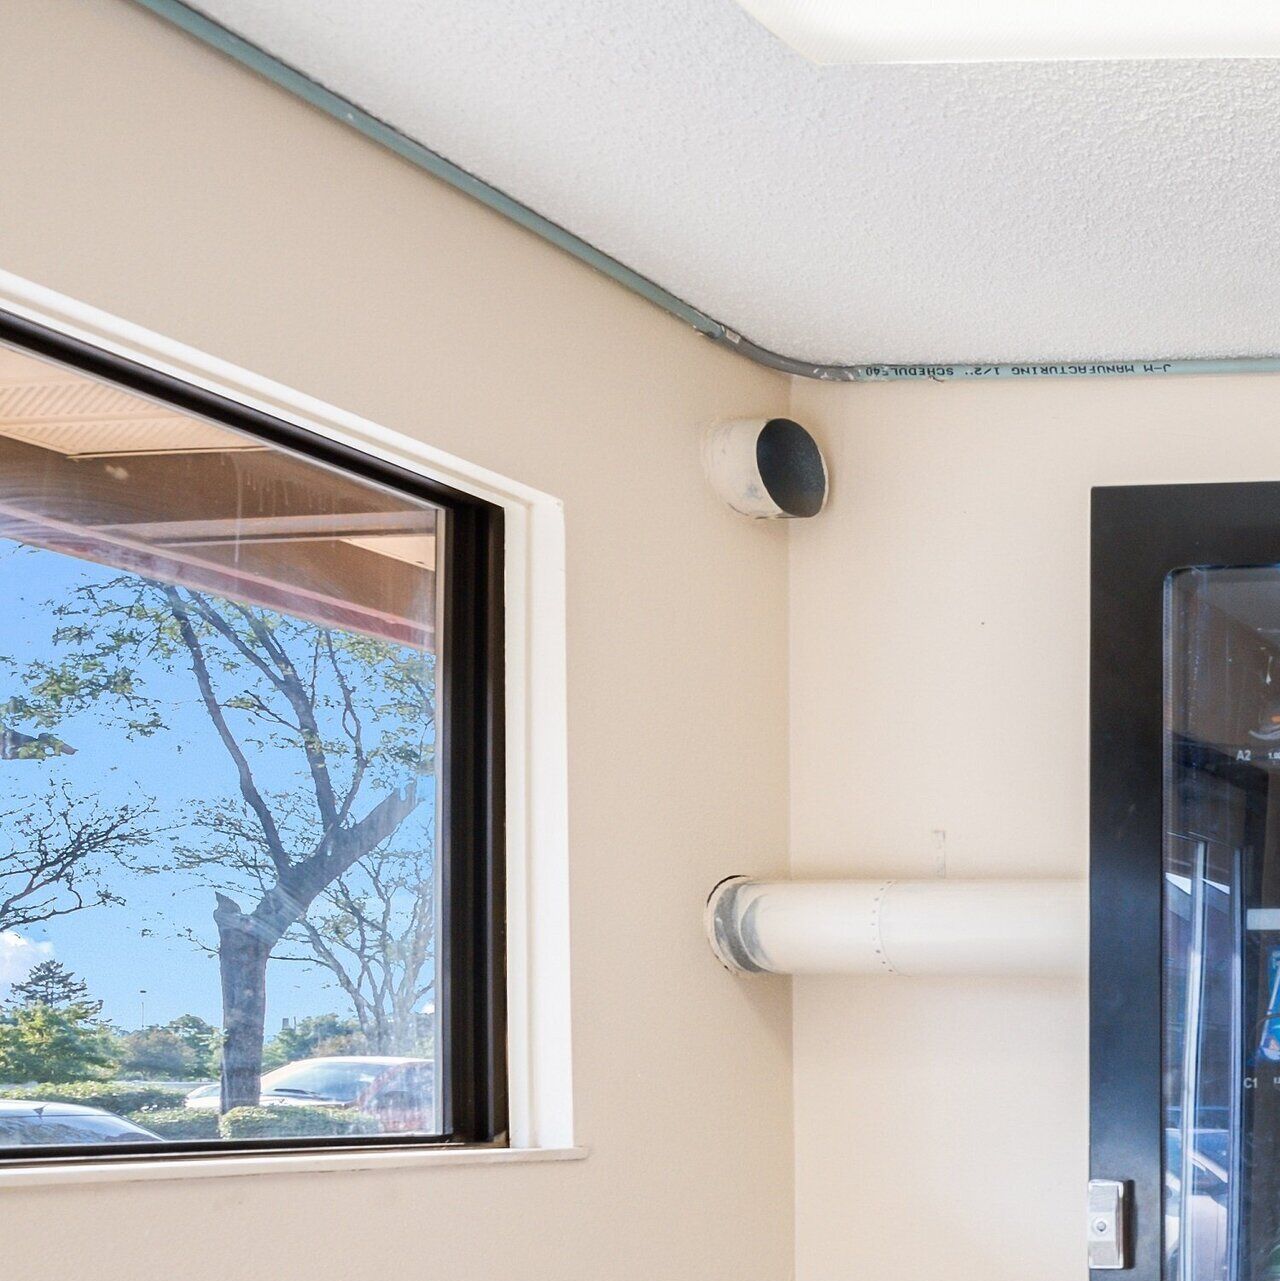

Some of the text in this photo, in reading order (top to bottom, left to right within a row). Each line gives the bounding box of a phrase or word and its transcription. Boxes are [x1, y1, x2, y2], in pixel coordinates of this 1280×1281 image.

[1011, 364, 1135, 375] MANUFACTURING
[1143, 363, 1172, 373] J-M
[1236, 750, 1252, 761] A2
[1243, 1077, 1258, 1089] C1
